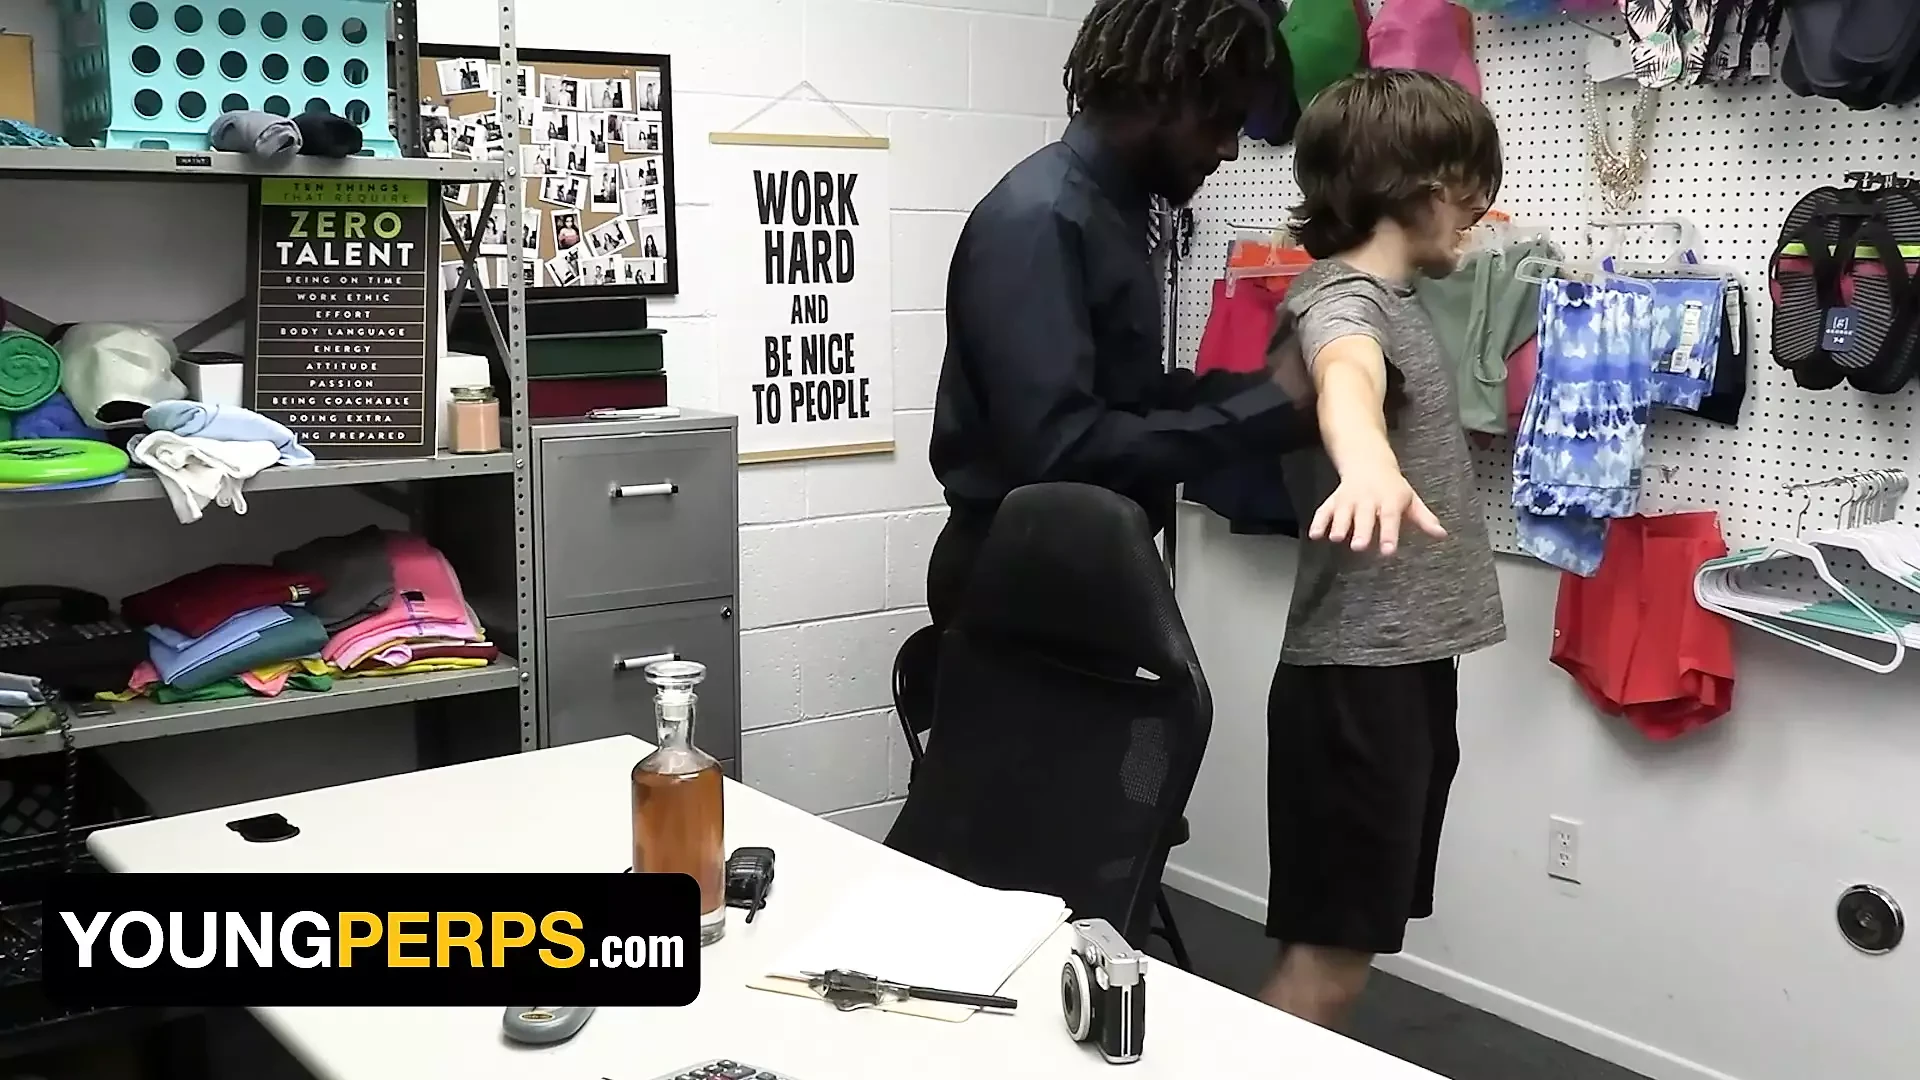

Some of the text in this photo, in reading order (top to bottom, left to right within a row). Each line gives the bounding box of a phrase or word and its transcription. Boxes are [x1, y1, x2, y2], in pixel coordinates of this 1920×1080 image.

[294, 183, 399, 192] TEN THINGS
[284, 193, 409, 203] THAT REQUIRE
[753, 169, 860, 227] WORK
[289, 211, 402, 239] ZERO
[276, 241, 414, 267] TALENT
[764, 229, 855, 285] HARD
[285, 276, 402, 285] BEING ON TIME
[297, 292, 390, 302] WORK ETHIC
[315, 310, 371, 319] EFFORT
[790, 294, 829, 325] AND
[280, 327, 405, 337] BODY LANGUAGE
[314, 345, 371, 353] ENERGY
[764, 332, 856, 379] BE NICE
[305, 362, 378, 371] ATTITUDE
[309, 379, 374, 388] PASSION
[272, 396, 410, 406] BEING COACHABLE
[751, 377, 871, 425] TO PEOPLE
[289, 414, 393, 423] DOING EXTRA
[295, 431, 406, 440] ING PREPARED
